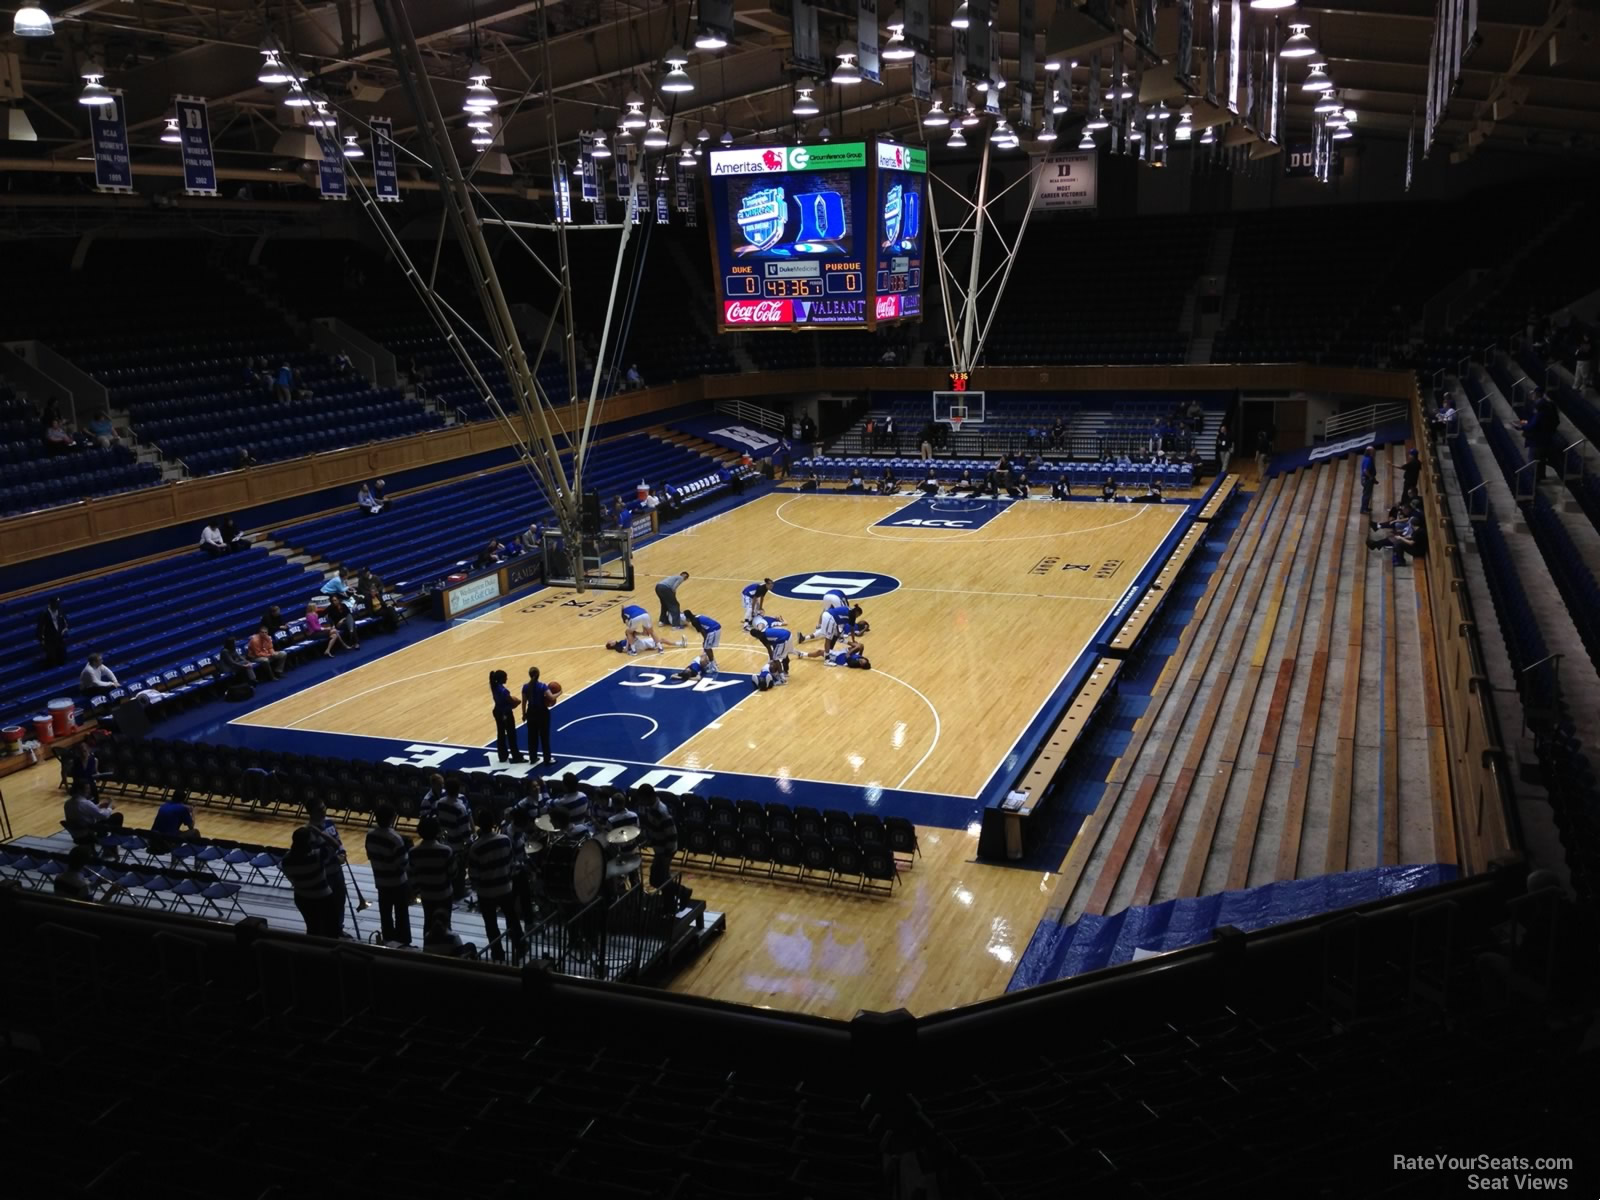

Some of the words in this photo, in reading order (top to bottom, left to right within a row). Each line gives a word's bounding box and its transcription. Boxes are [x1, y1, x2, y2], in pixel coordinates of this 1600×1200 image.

[97, 153, 112, 161] FINAL
[114, 155, 128, 163] FOUR
[809, 153, 845, 161] Circumference
[732, 266, 753, 274] DUKE
[825, 262, 861, 271] PURDUE
[746, 277, 755, 293] 0
[767, 280, 809, 296] 43:36
[846, 274, 856, 291] 0
[726, 300, 784, 322] Coca-Cola
[812, 300, 864, 314] VALEANT
[892, 519, 973, 528] ACC
[618, 673, 744, 692] ACC
[383, 743, 715, 797] DUKE
